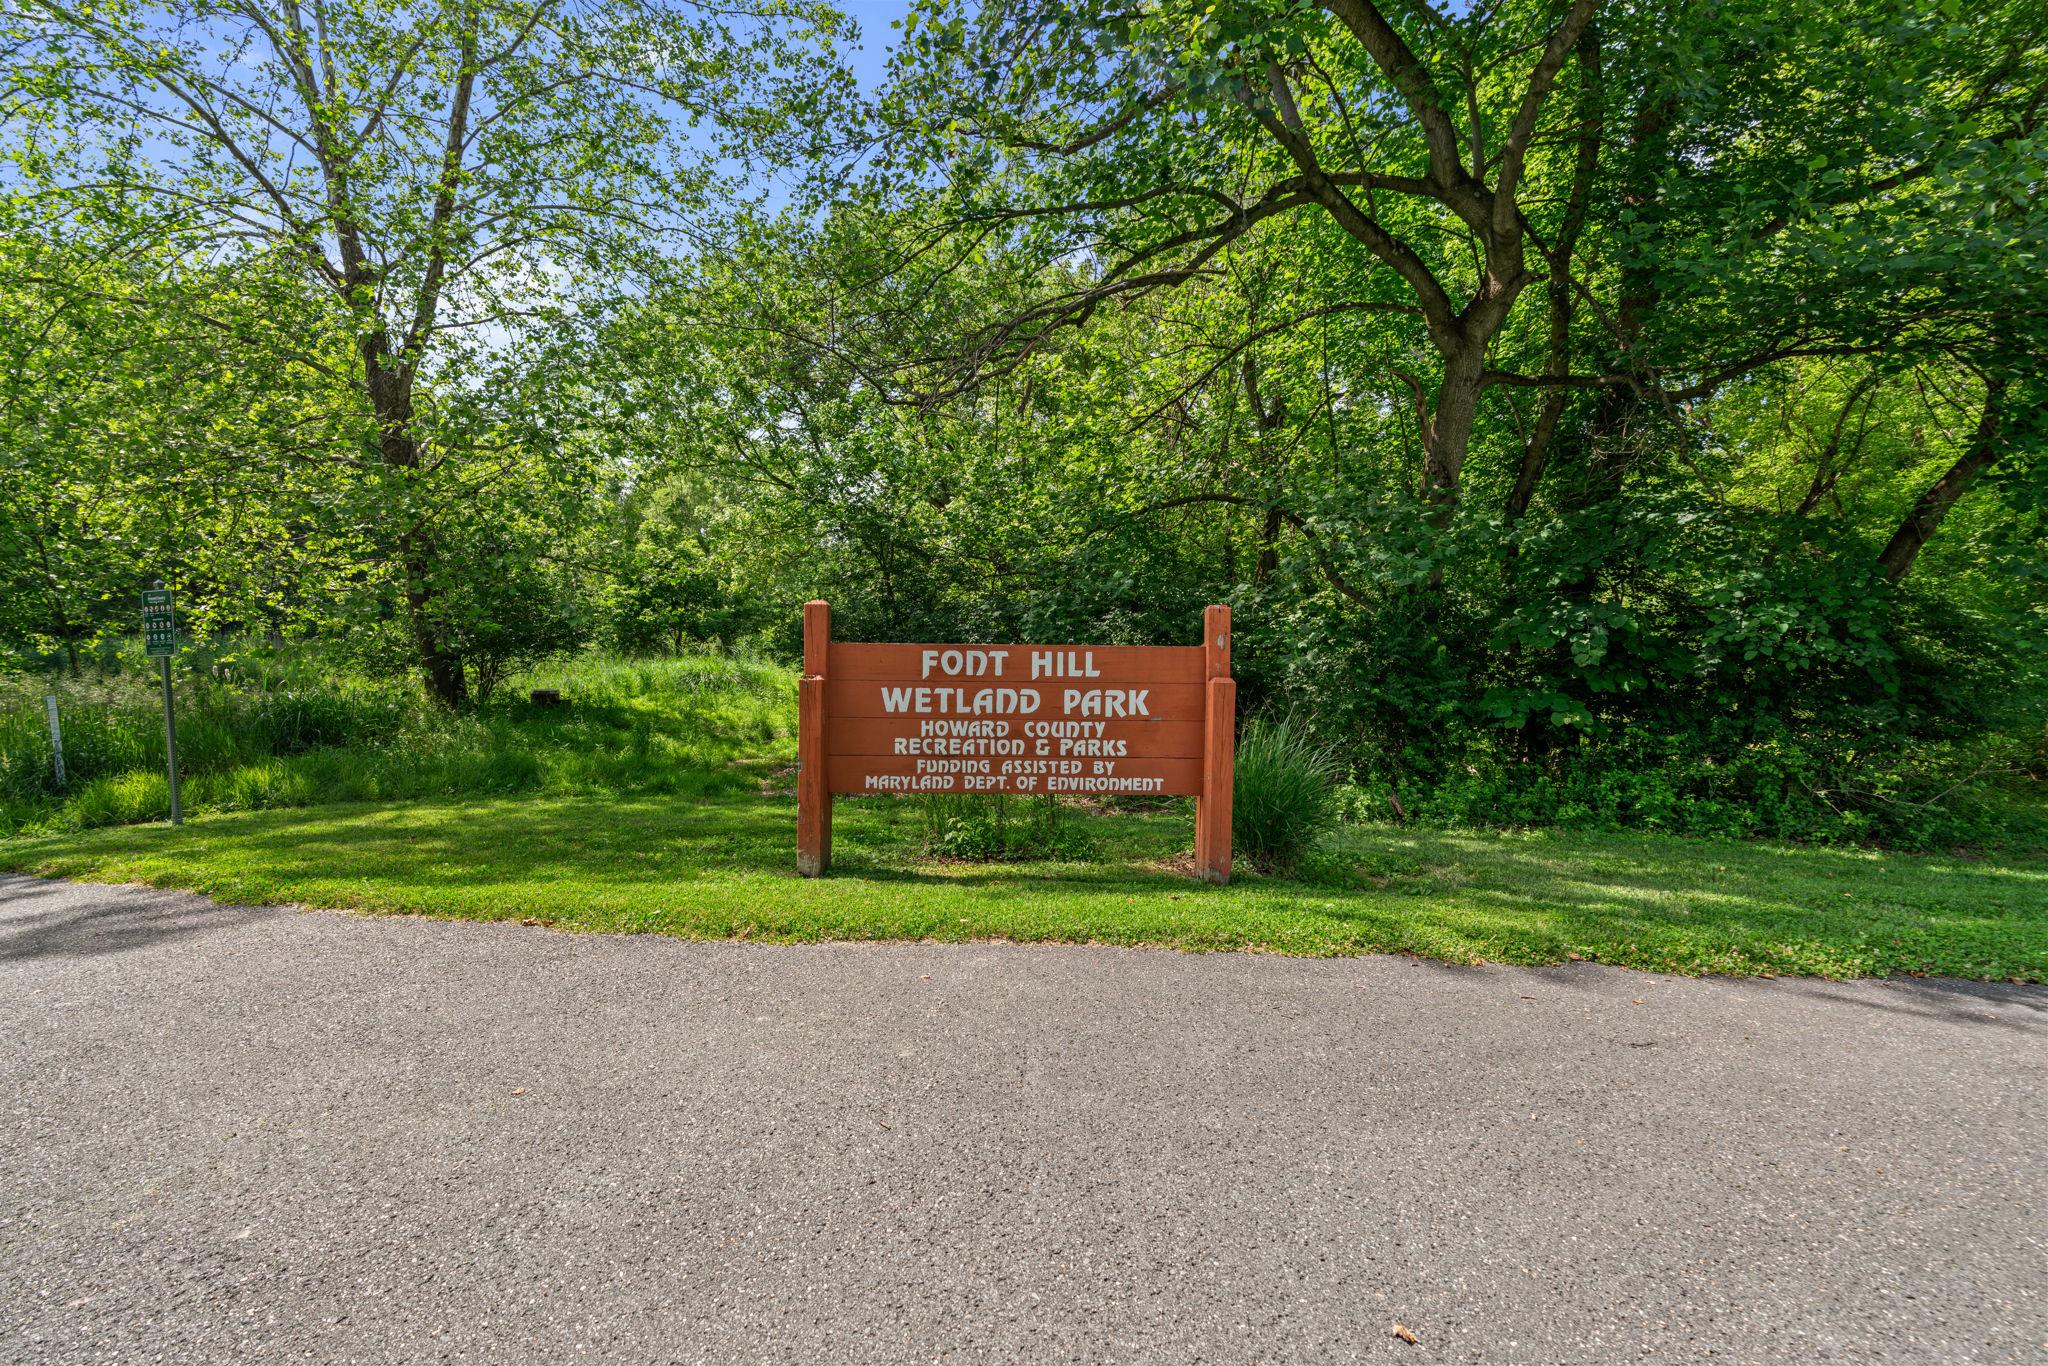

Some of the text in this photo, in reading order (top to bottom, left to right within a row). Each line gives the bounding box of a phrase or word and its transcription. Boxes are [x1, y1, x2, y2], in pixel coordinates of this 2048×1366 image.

[923, 650, 1100, 680] FONT HILL
[881, 687, 1149, 717] WETLAND PARK
[920, 720, 1105, 738] HOWARD COUNTY
[895, 738, 1127, 756] RECREATION & PARKS
[917, 760, 1115, 776] FUNDING ASSISTED BY
[866, 776, 1163, 791] MARYLAND DEPT. OF ENVIRONMENT
